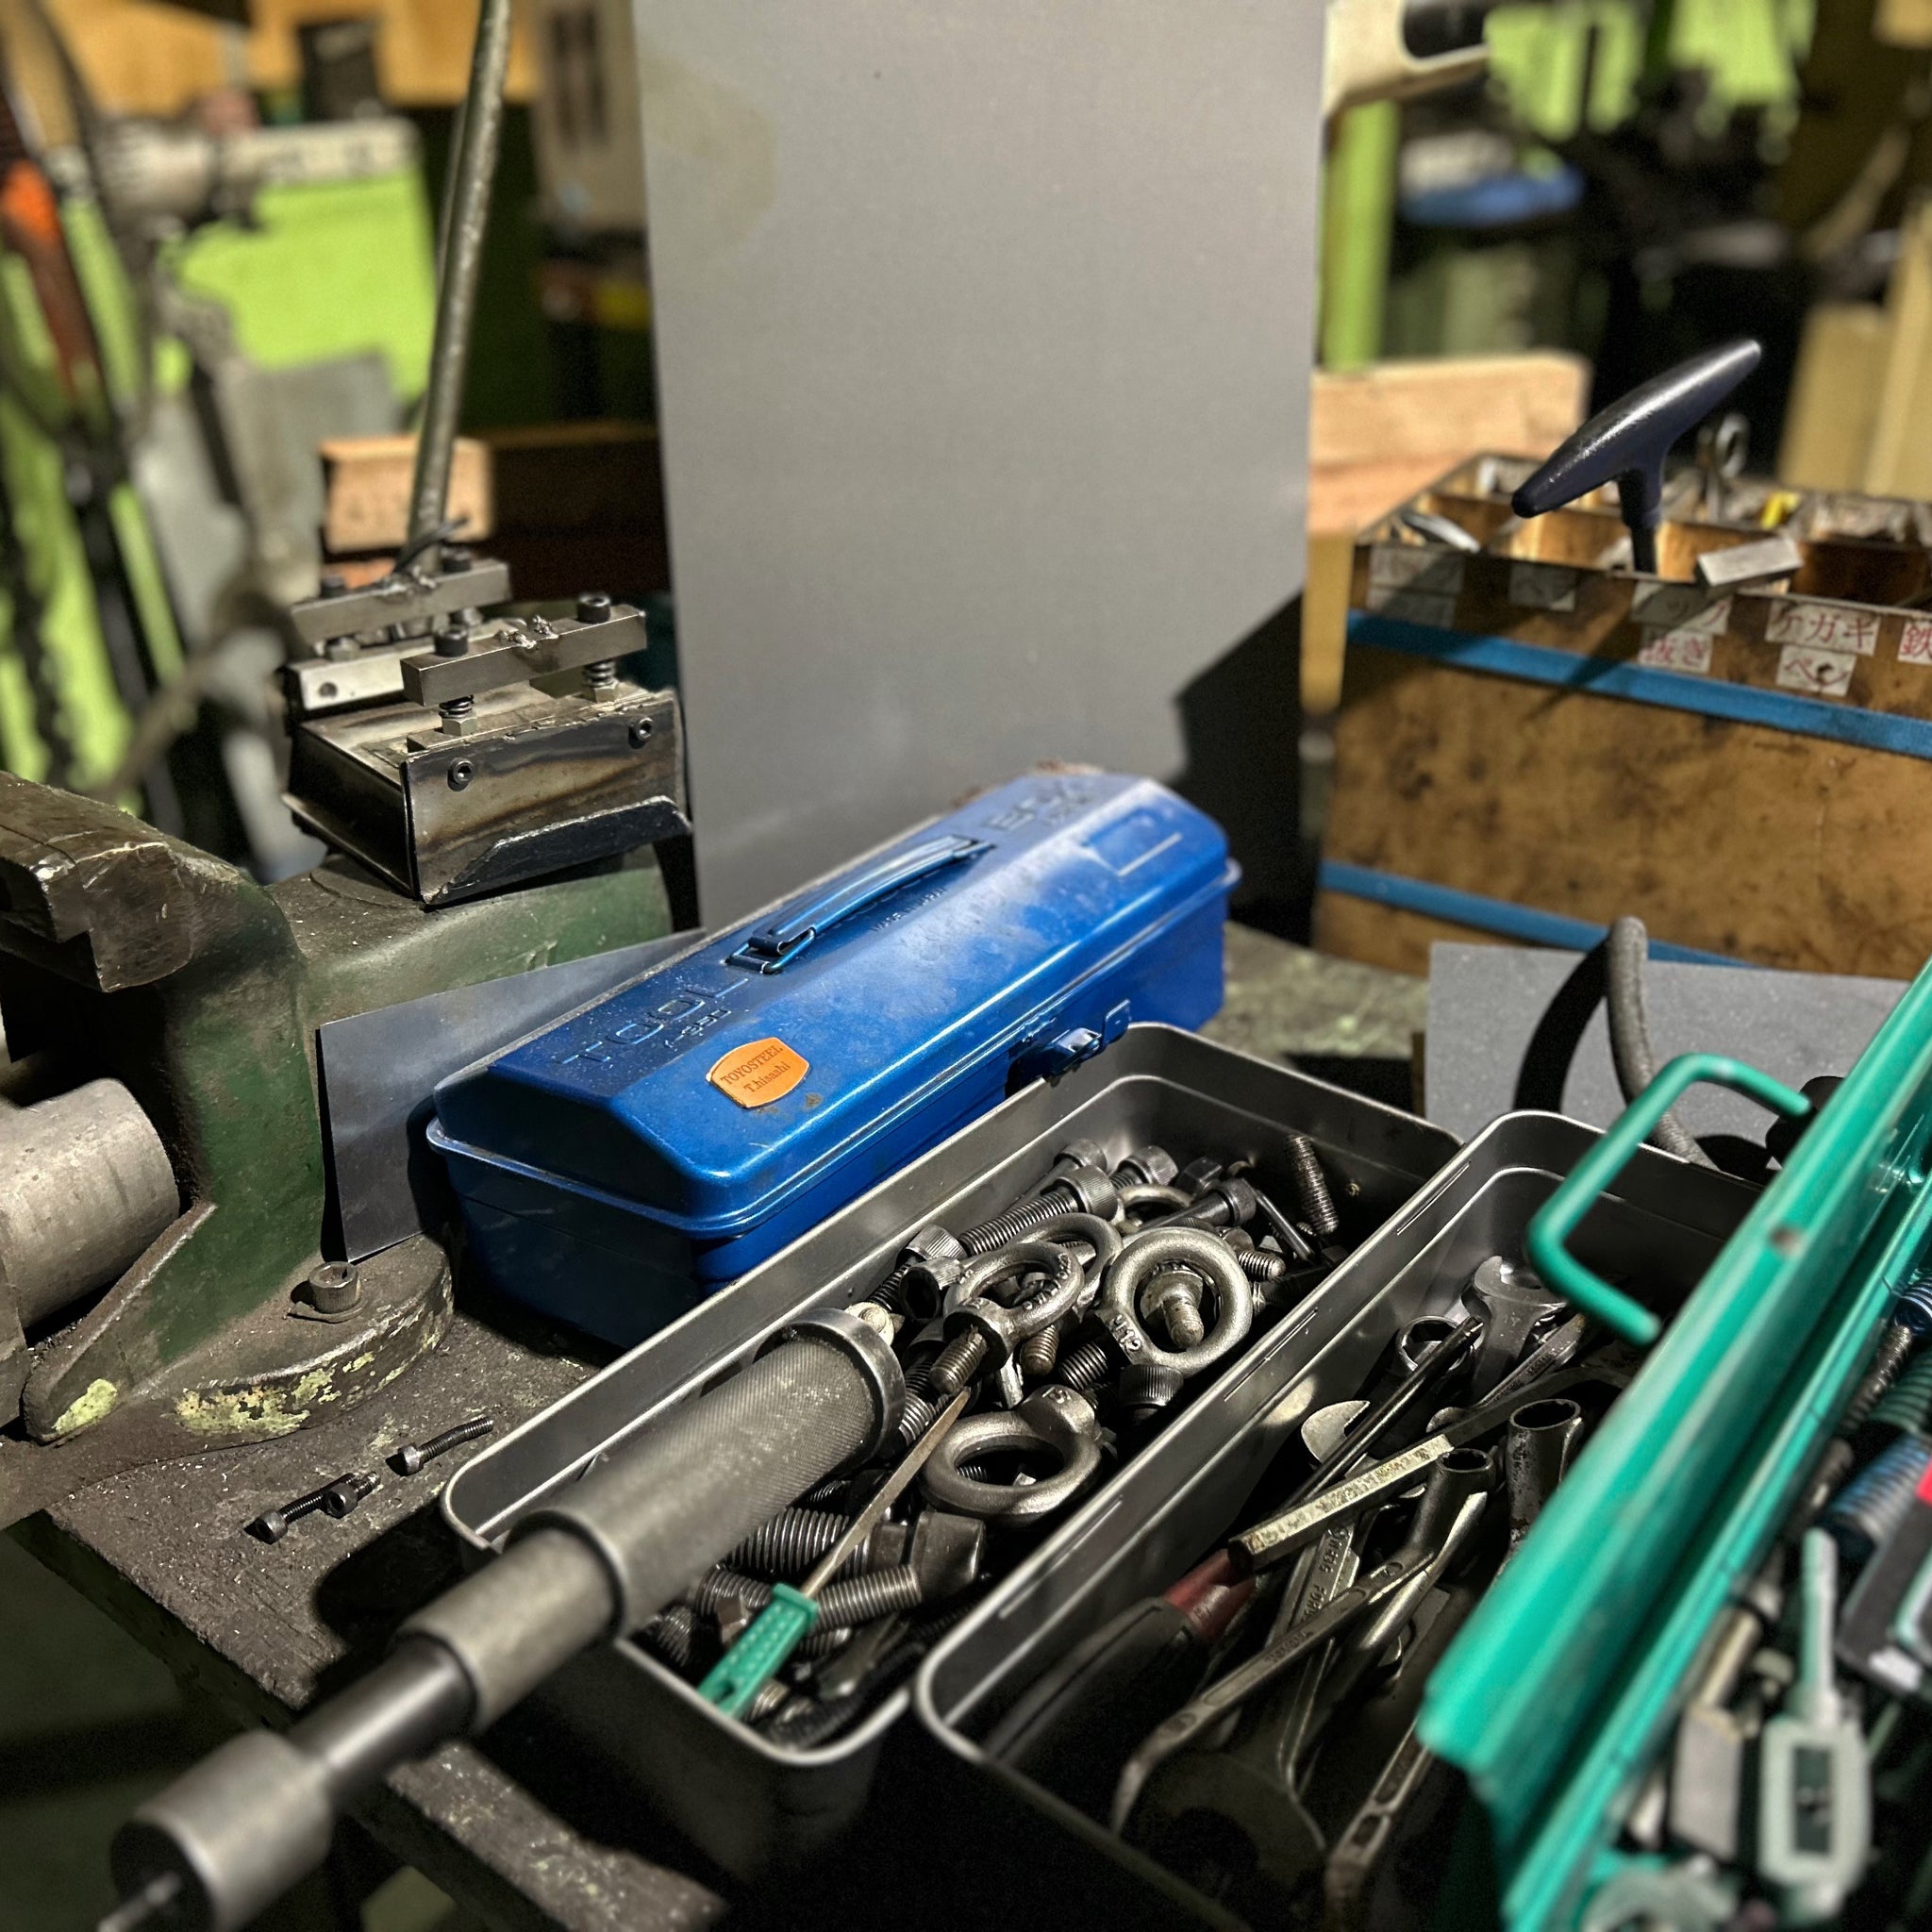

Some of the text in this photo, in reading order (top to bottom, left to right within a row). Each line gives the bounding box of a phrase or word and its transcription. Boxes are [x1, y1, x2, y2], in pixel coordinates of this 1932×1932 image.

[554, 977, 749, 1064] TOOL
[720, 1044, 784, 1086] TOYOSTEEL
[742, 1060, 791, 1093] T.hisashi
